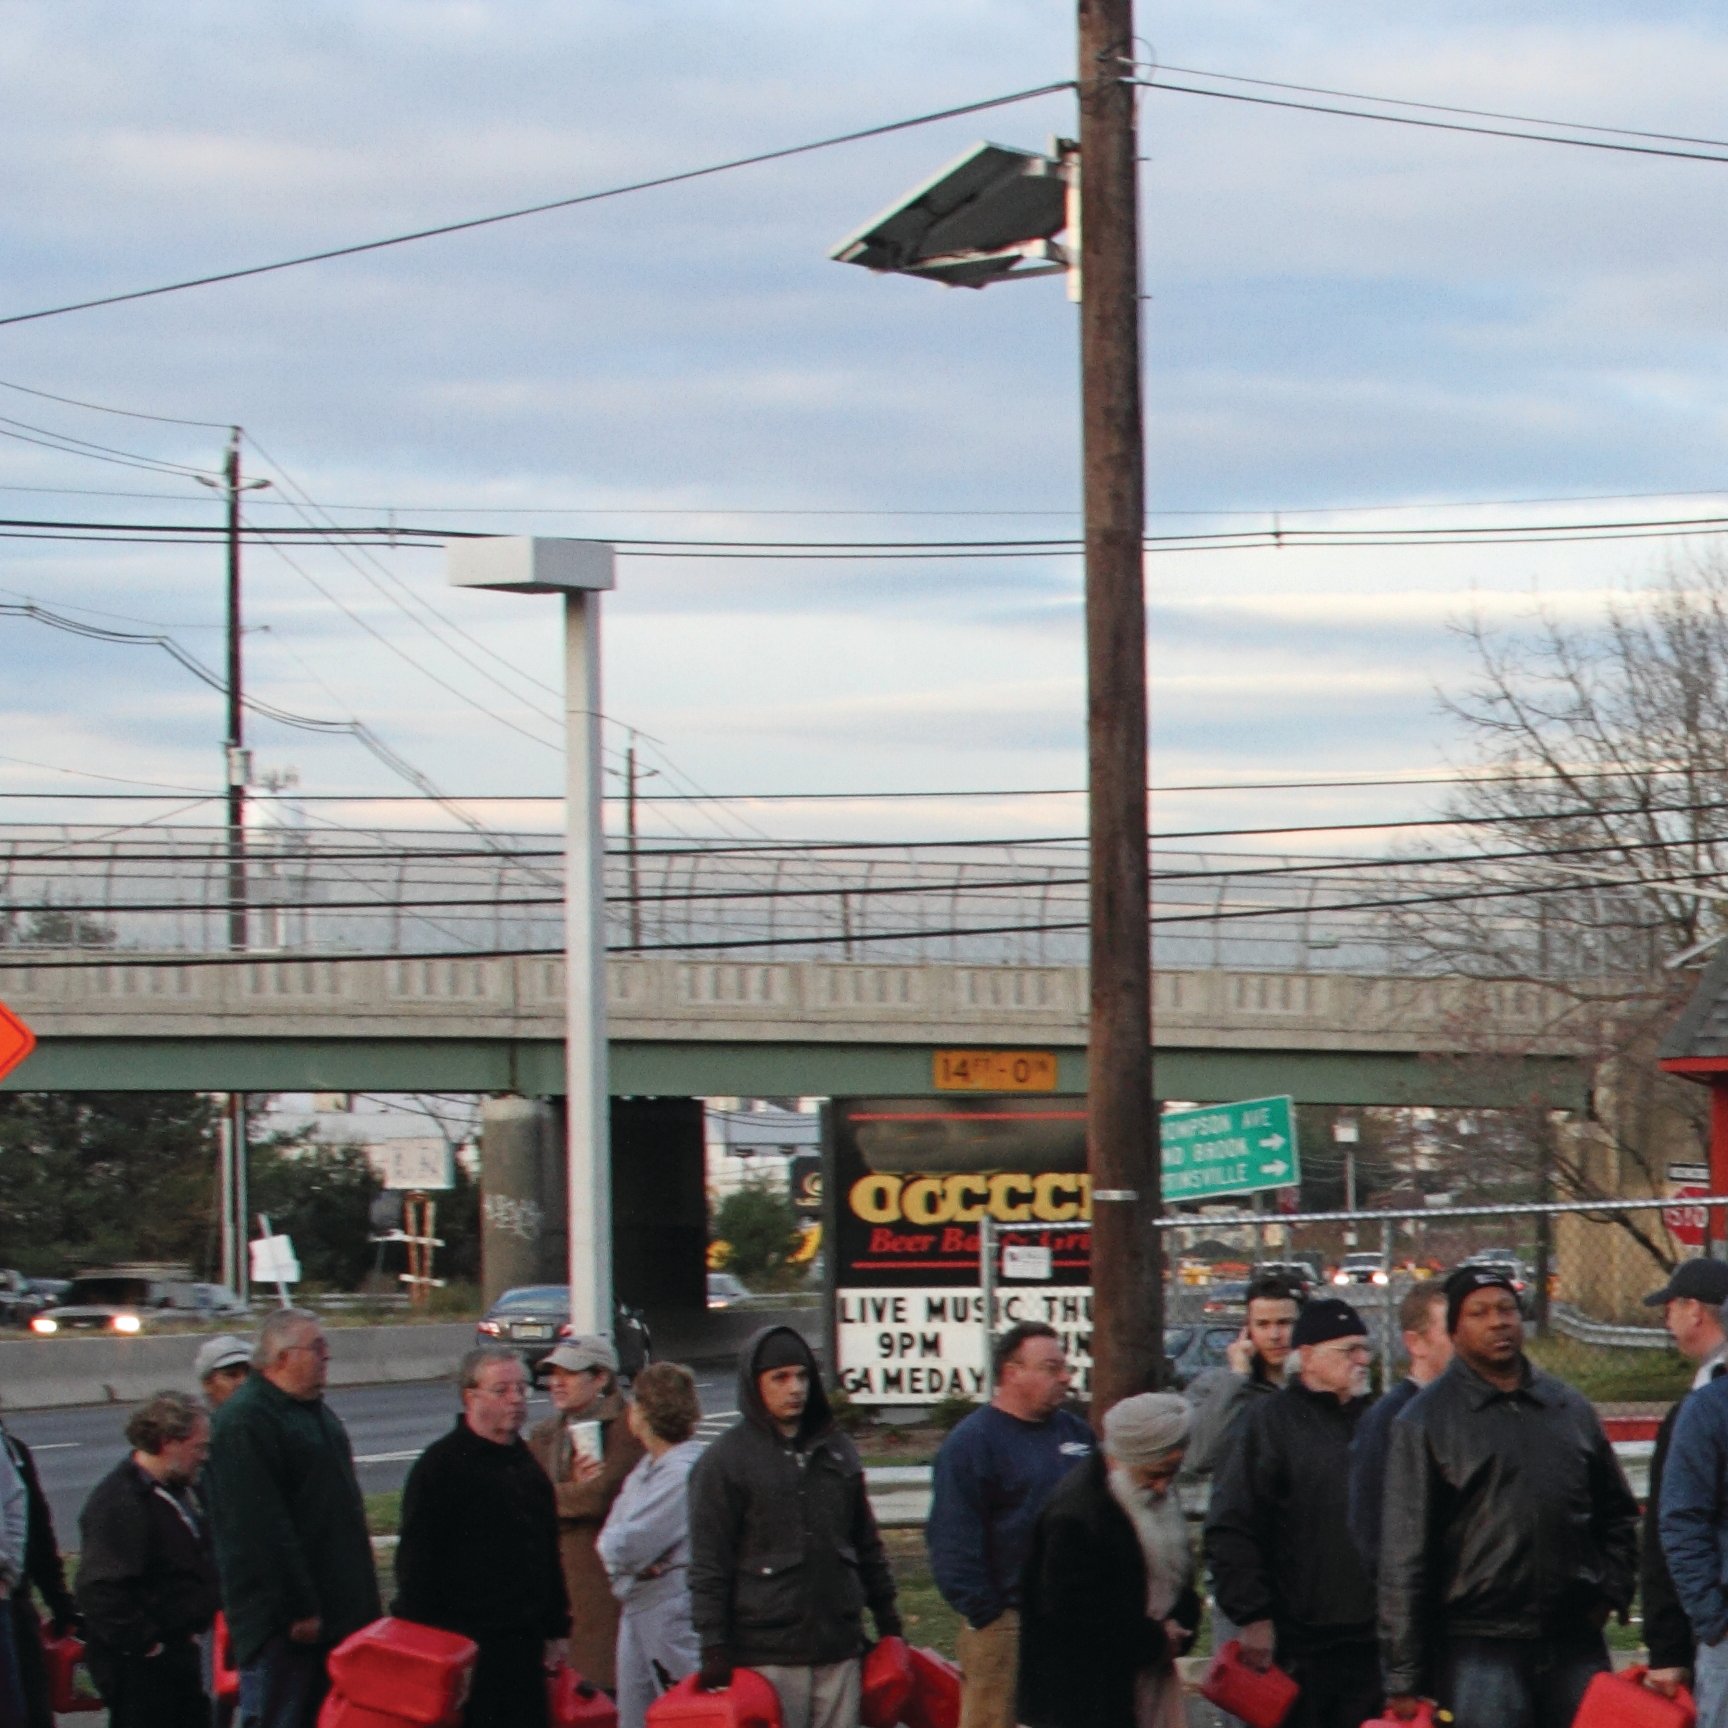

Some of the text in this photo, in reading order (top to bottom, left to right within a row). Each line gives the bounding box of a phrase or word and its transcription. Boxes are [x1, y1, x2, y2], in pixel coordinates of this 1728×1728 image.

[1160, 1107, 1272, 1140] OMPSON AVE
[1192, 1137, 1250, 1162] BROOK
[1160, 1163, 1249, 1191] TINSVILLE
[1664, 1205, 1709, 1229] STO
[869, 1227, 937, 1252] Beer
[942, 1227, 982, 1252] Ba
[841, 1296, 907, 1324] LIVE
[877, 1331, 942, 1359] 9PM
[842, 1366, 986, 1395] GAMEDAY
